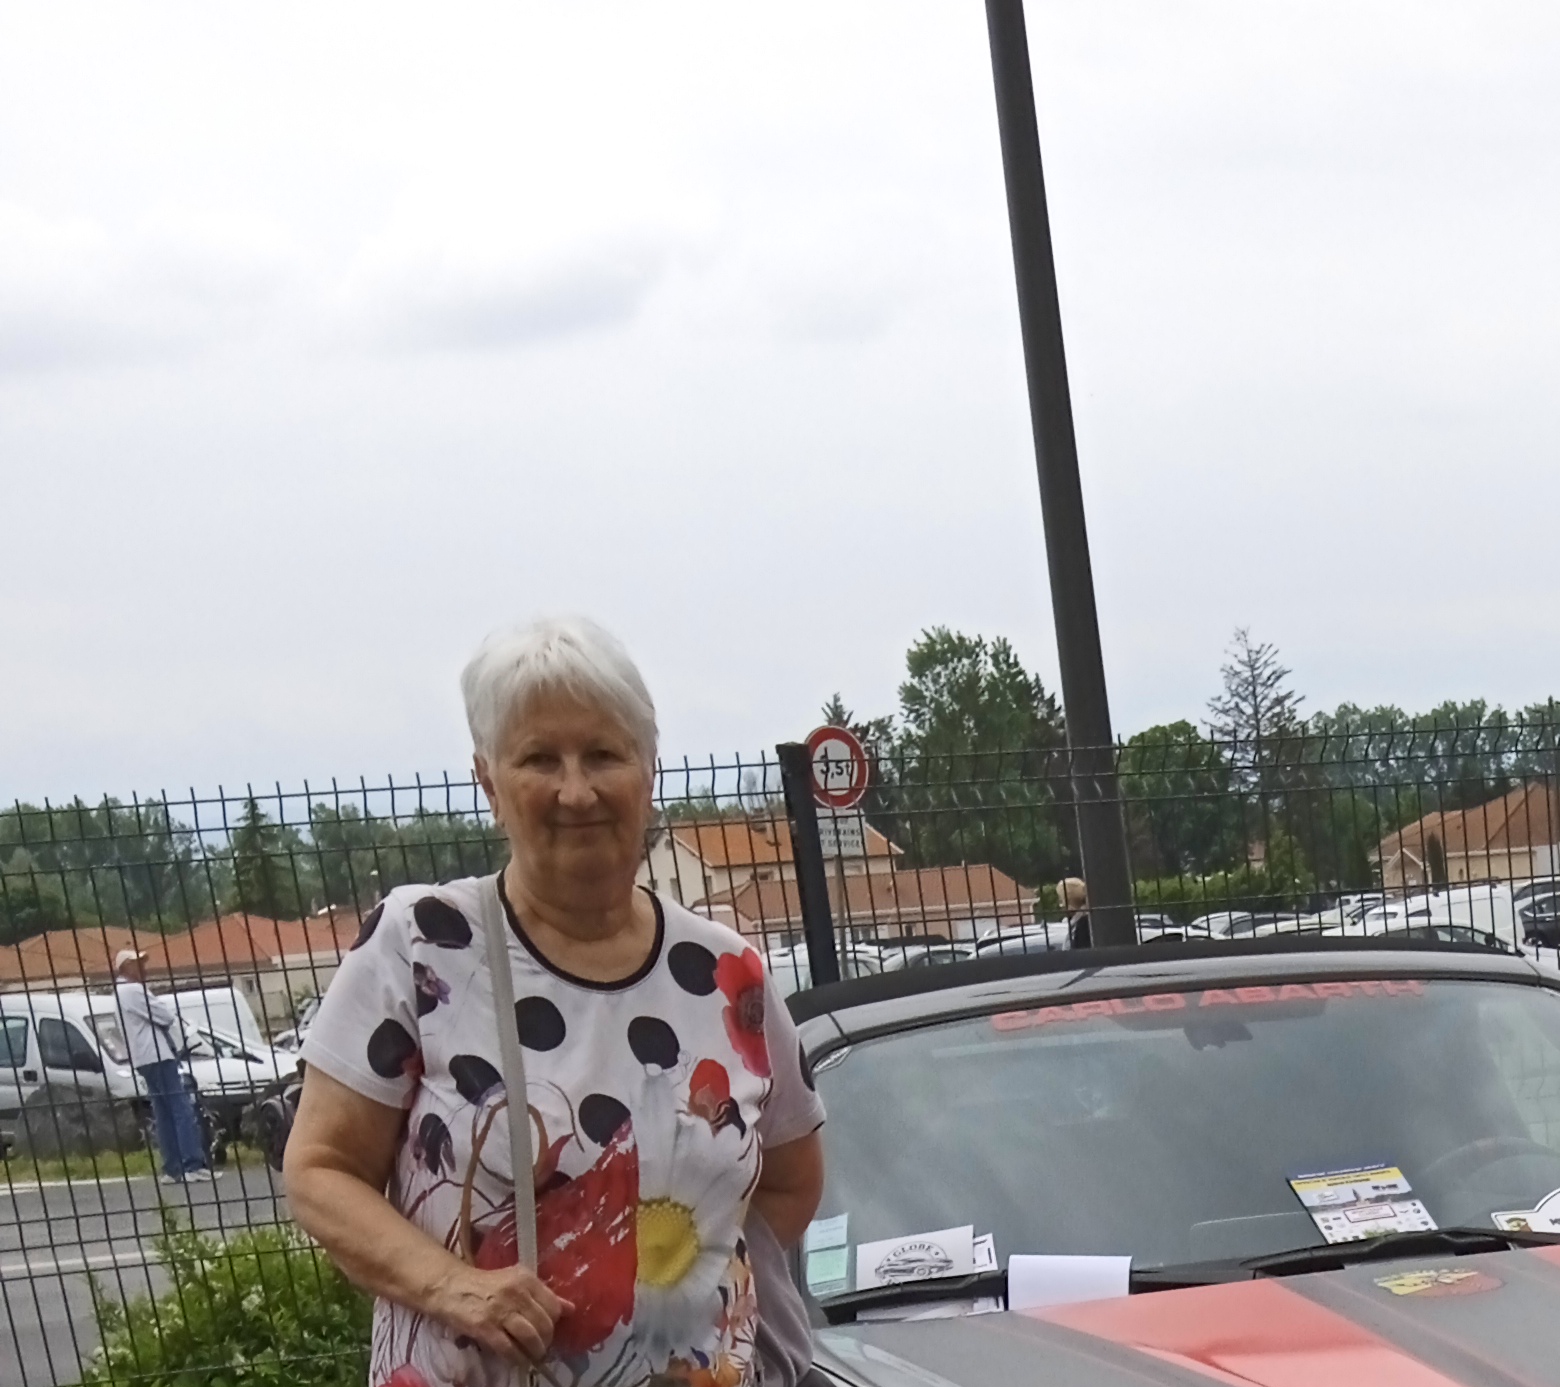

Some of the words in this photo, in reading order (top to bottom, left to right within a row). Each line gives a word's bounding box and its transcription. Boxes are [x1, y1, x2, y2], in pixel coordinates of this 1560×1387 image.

[991, 993, 1187, 1032] CARLO
[1199, 980, 1426, 1007] ABARTH
[892, 1243, 934, 1258] GLOBE
